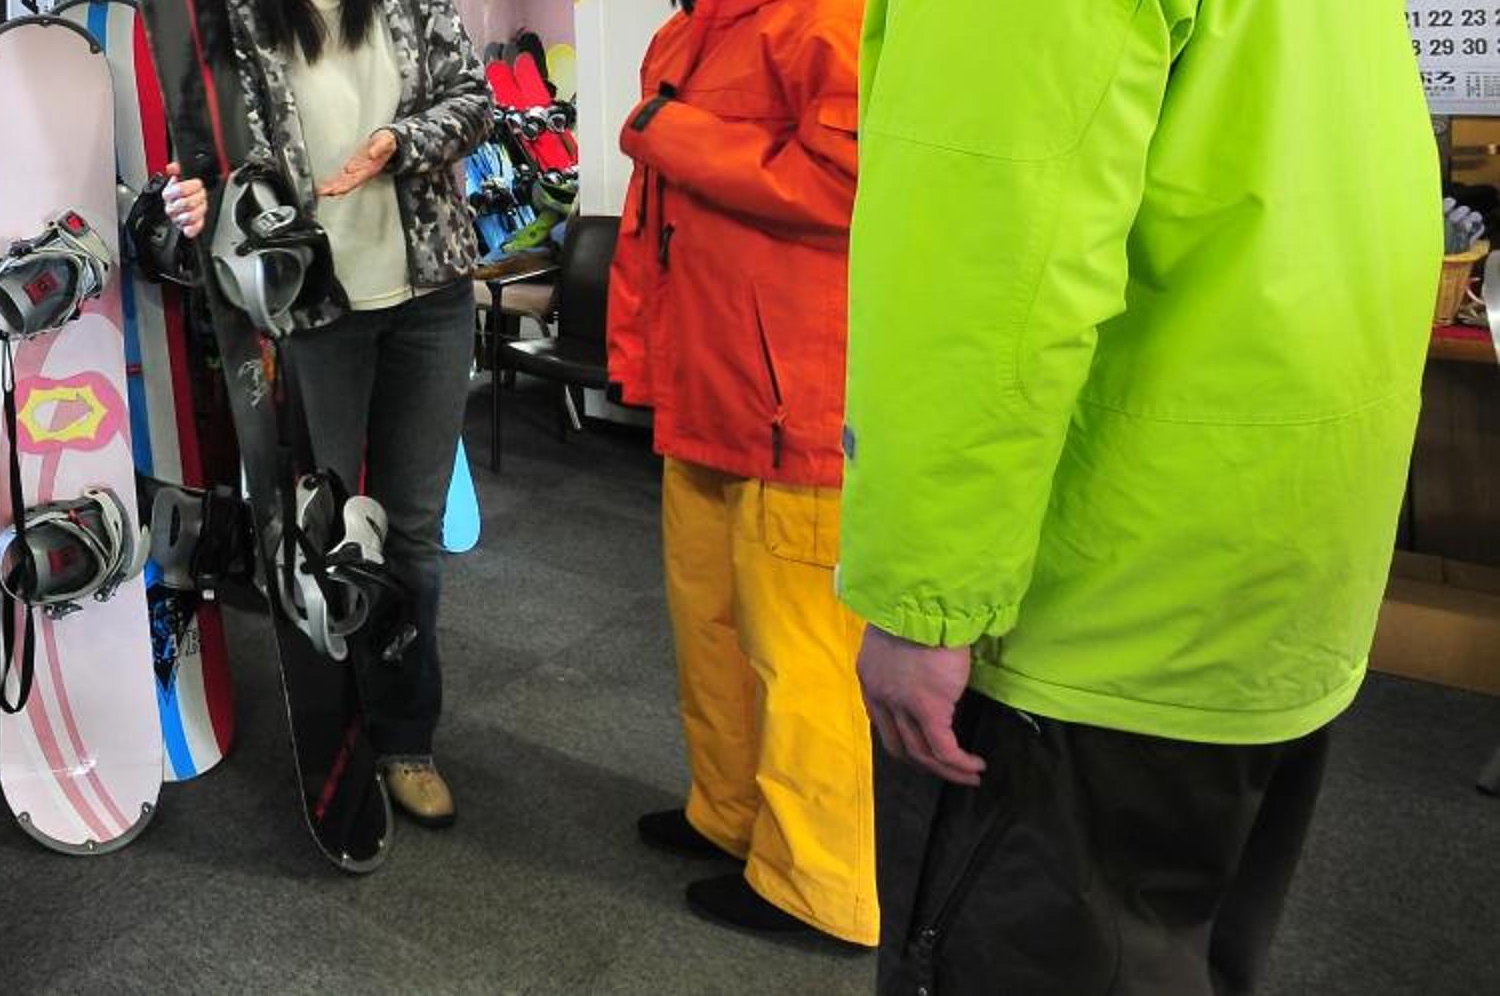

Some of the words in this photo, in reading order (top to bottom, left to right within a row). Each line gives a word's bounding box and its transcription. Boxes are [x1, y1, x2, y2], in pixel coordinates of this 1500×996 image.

[1427, 10, 1453, 26] 22
[1461, 9, 1486, 26] 23
[1429, 39, 1454, 55] 29
[1462, 37, 1487, 55] 30
